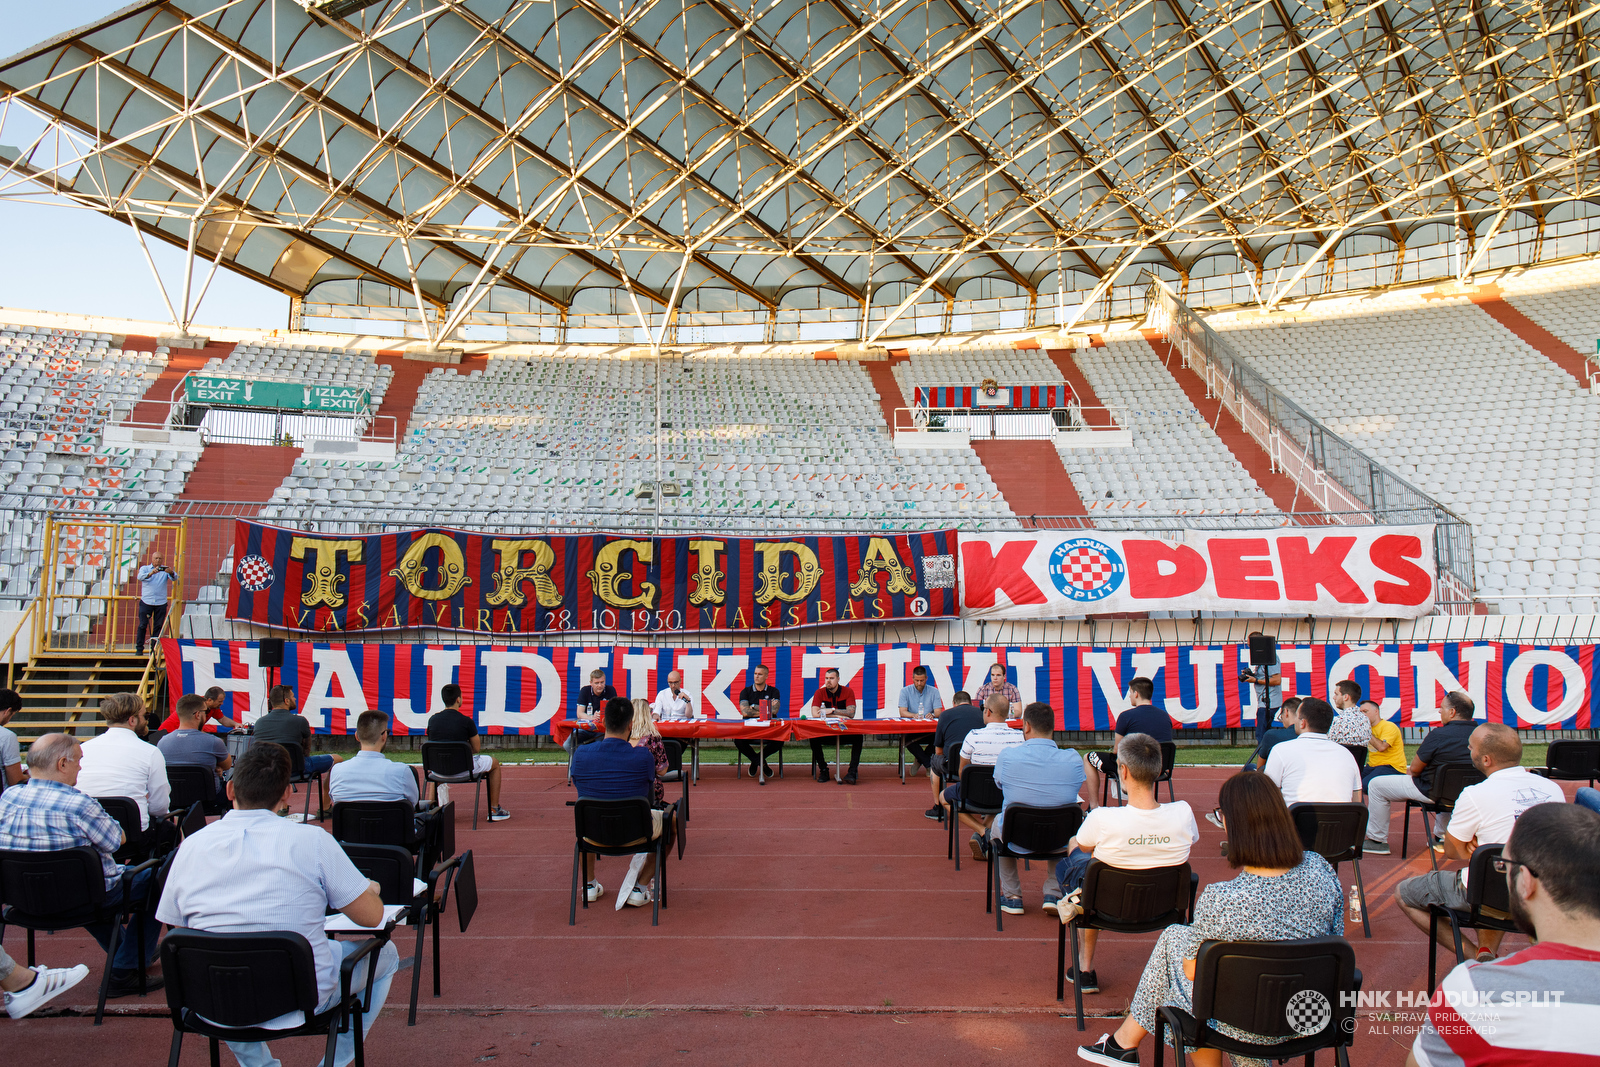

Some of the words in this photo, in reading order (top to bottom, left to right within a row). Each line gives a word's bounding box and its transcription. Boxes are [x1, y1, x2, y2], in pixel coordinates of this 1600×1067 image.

[192, 379, 240, 391] IZLAZ
[315, 387, 362, 399] IZLAZ
[197, 389, 235, 401] EXIT
[320, 398, 355, 409] EXIT
[1055, 539, 1110, 557] HAJDUK
[240, 555, 272, 571] HAJDUK
[290, 532, 916, 609] TORCIDA
[1061, 583, 1113, 600] SPLIT
[290, 600, 400, 631] VAŠA
[428, 602, 518, 632] VIRA
[544, 609, 576, 631] 28.
[630, 609, 683, 631] 1950.
[800, 646, 1043, 720] ŽIVI
[1127, 834, 1171, 846] održivo
